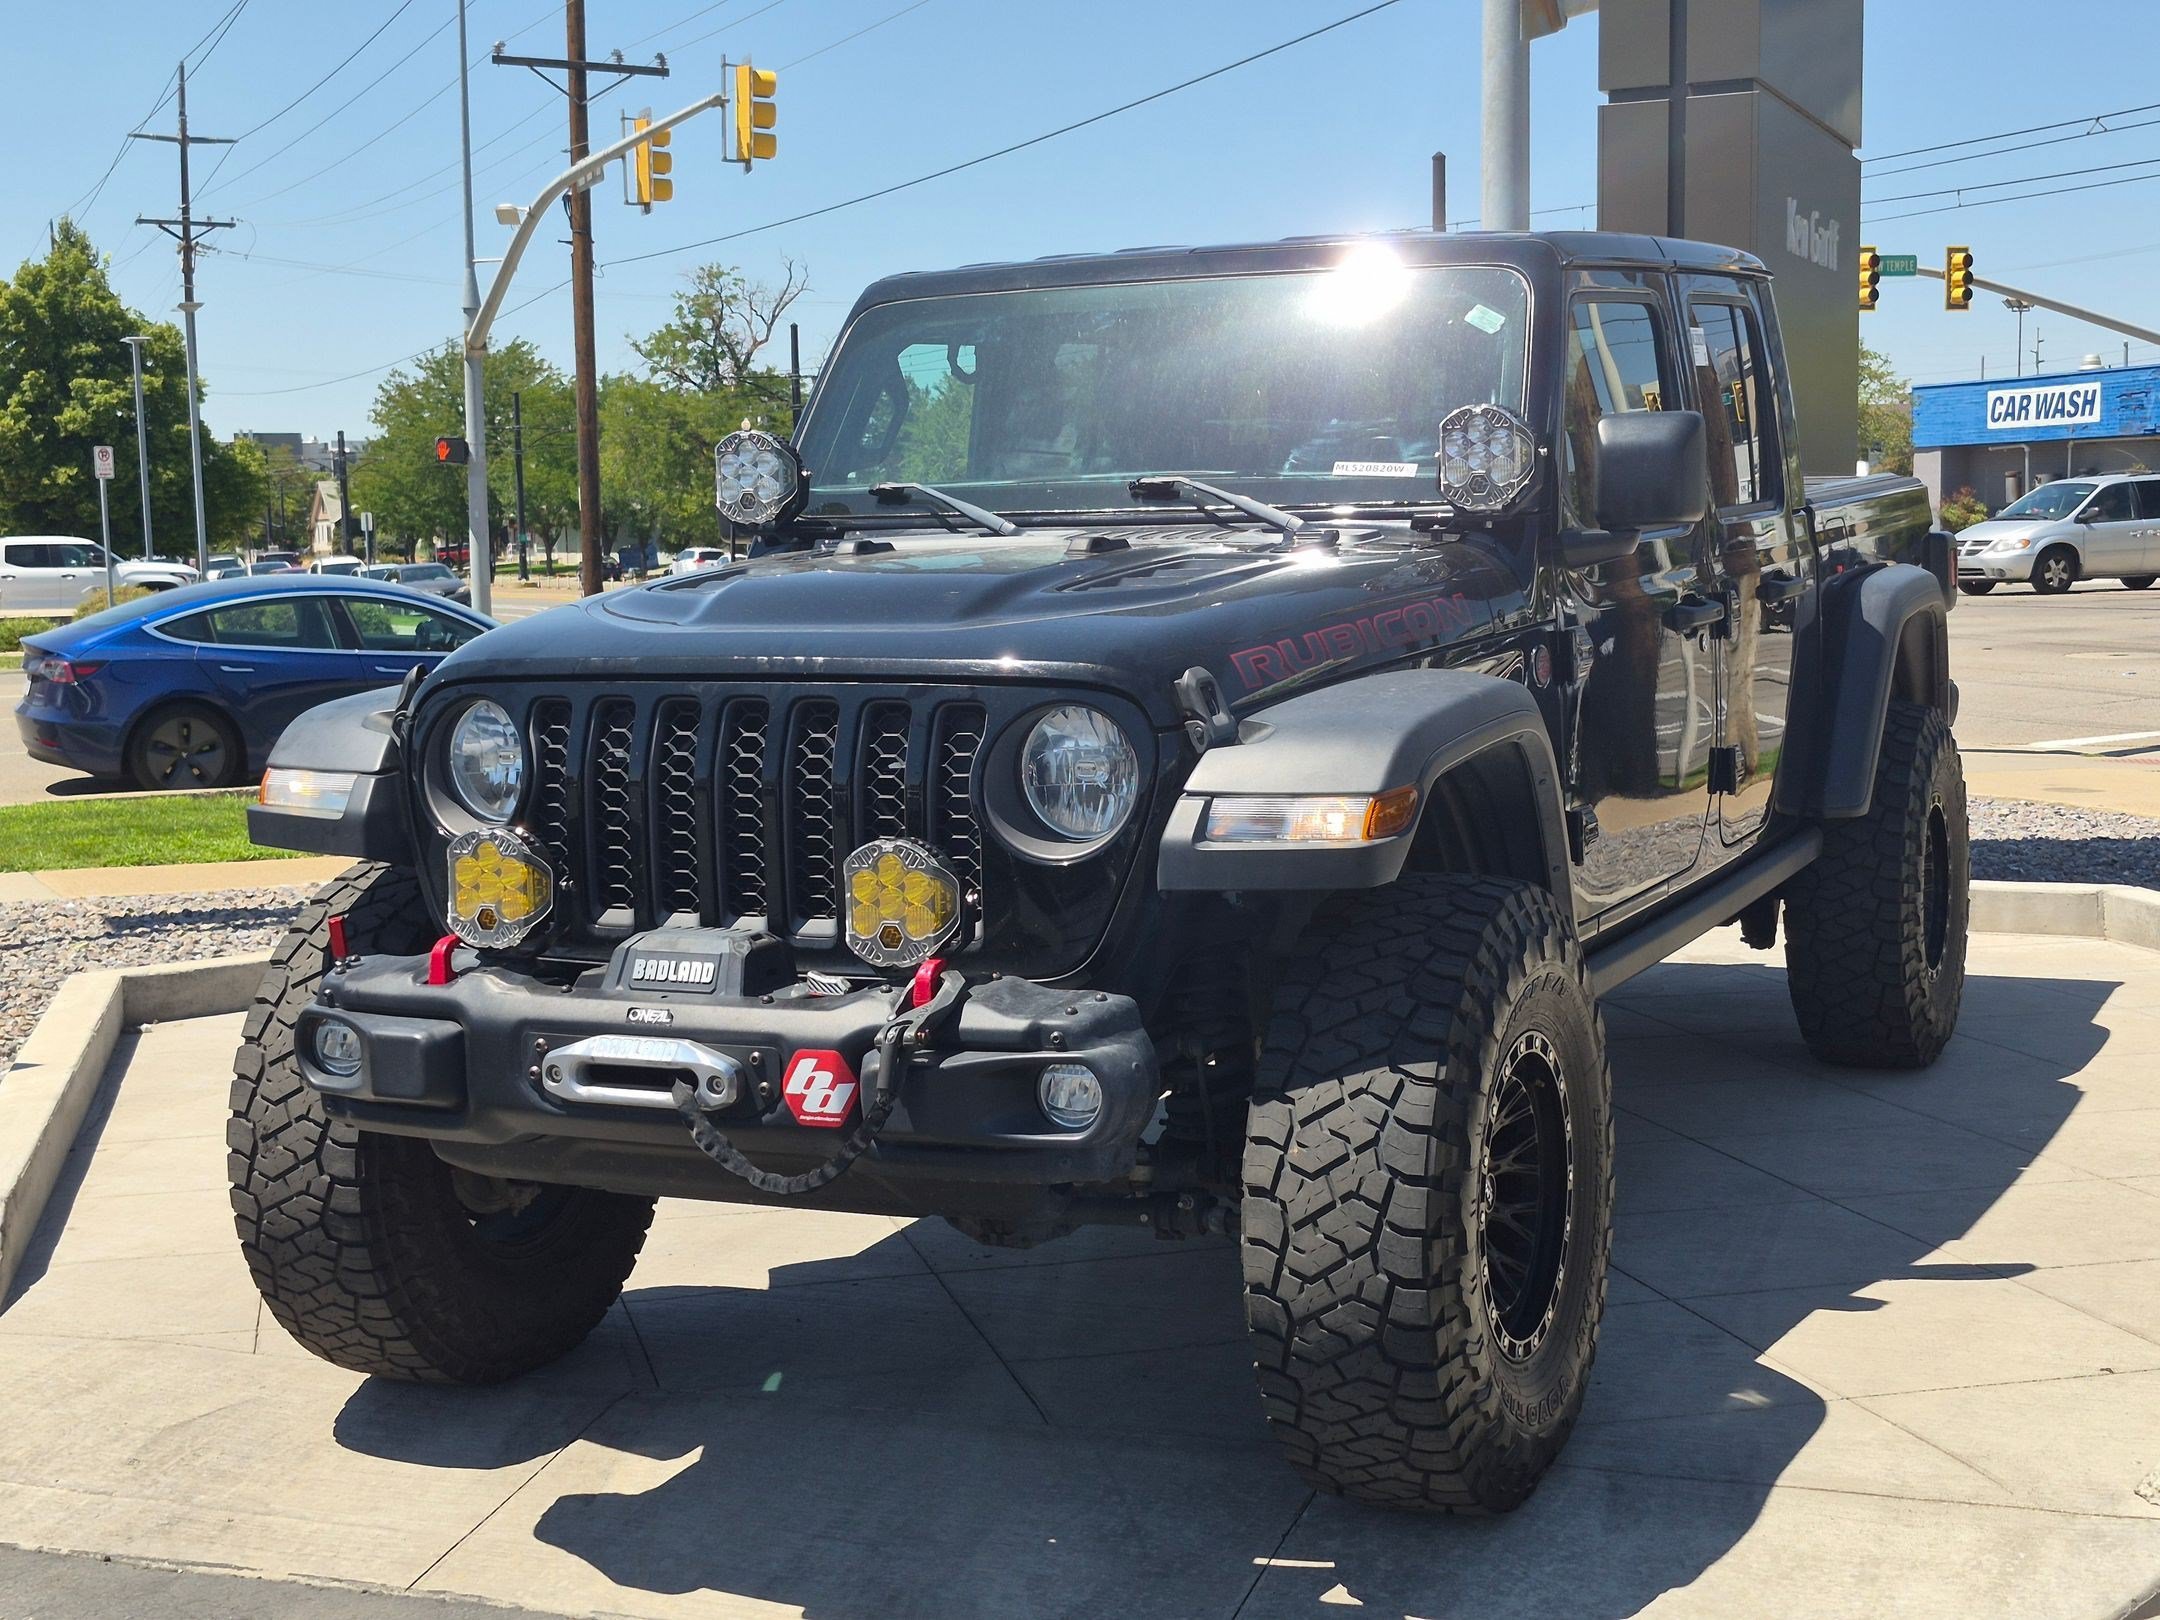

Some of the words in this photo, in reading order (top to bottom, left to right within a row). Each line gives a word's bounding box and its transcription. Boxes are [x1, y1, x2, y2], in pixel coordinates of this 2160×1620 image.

[1886, 259, 1916, 272] TEMPLE
[1990, 396, 2032, 423] CAR
[2034, 389, 2097, 421] WASH
[1230, 592, 1473, 690] RUBICON
[632, 958, 716, 984] BADLAND
